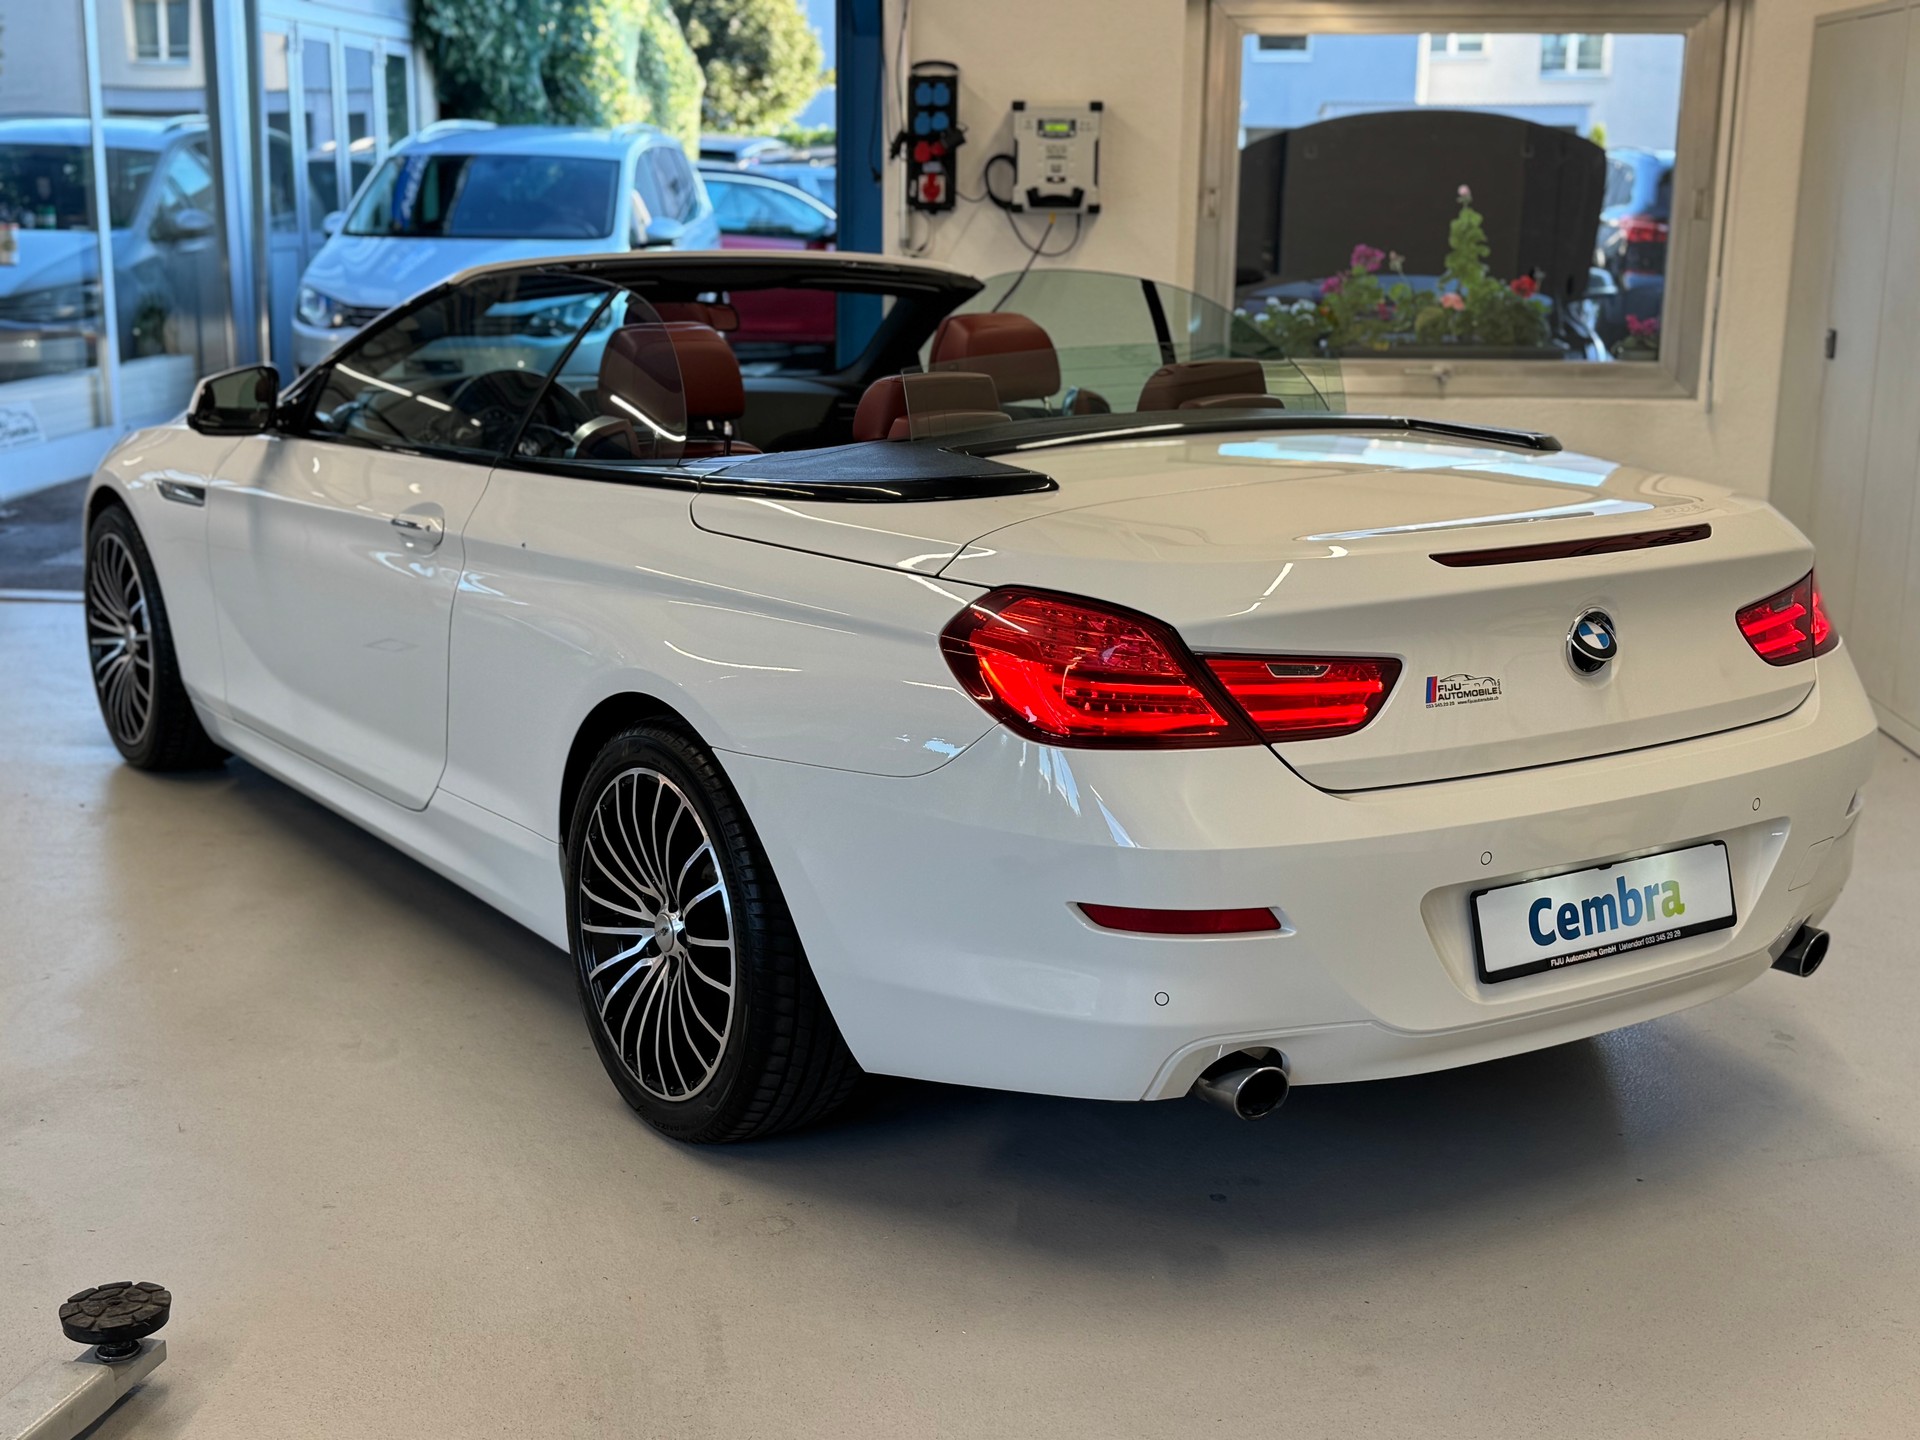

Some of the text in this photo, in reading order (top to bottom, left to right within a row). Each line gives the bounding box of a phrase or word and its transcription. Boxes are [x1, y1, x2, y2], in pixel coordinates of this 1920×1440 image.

[1438, 682, 1461, 693] FIJU
[1438, 687, 1498, 701] AUTOMOBILE
[1528, 875, 1686, 946] Cembra
[1550, 957, 1565, 967] FIJU
[1565, 950, 1598, 963] Automobile
[1598, 944, 1617, 955] GmbH
[1655, 932, 1666, 942] 345
